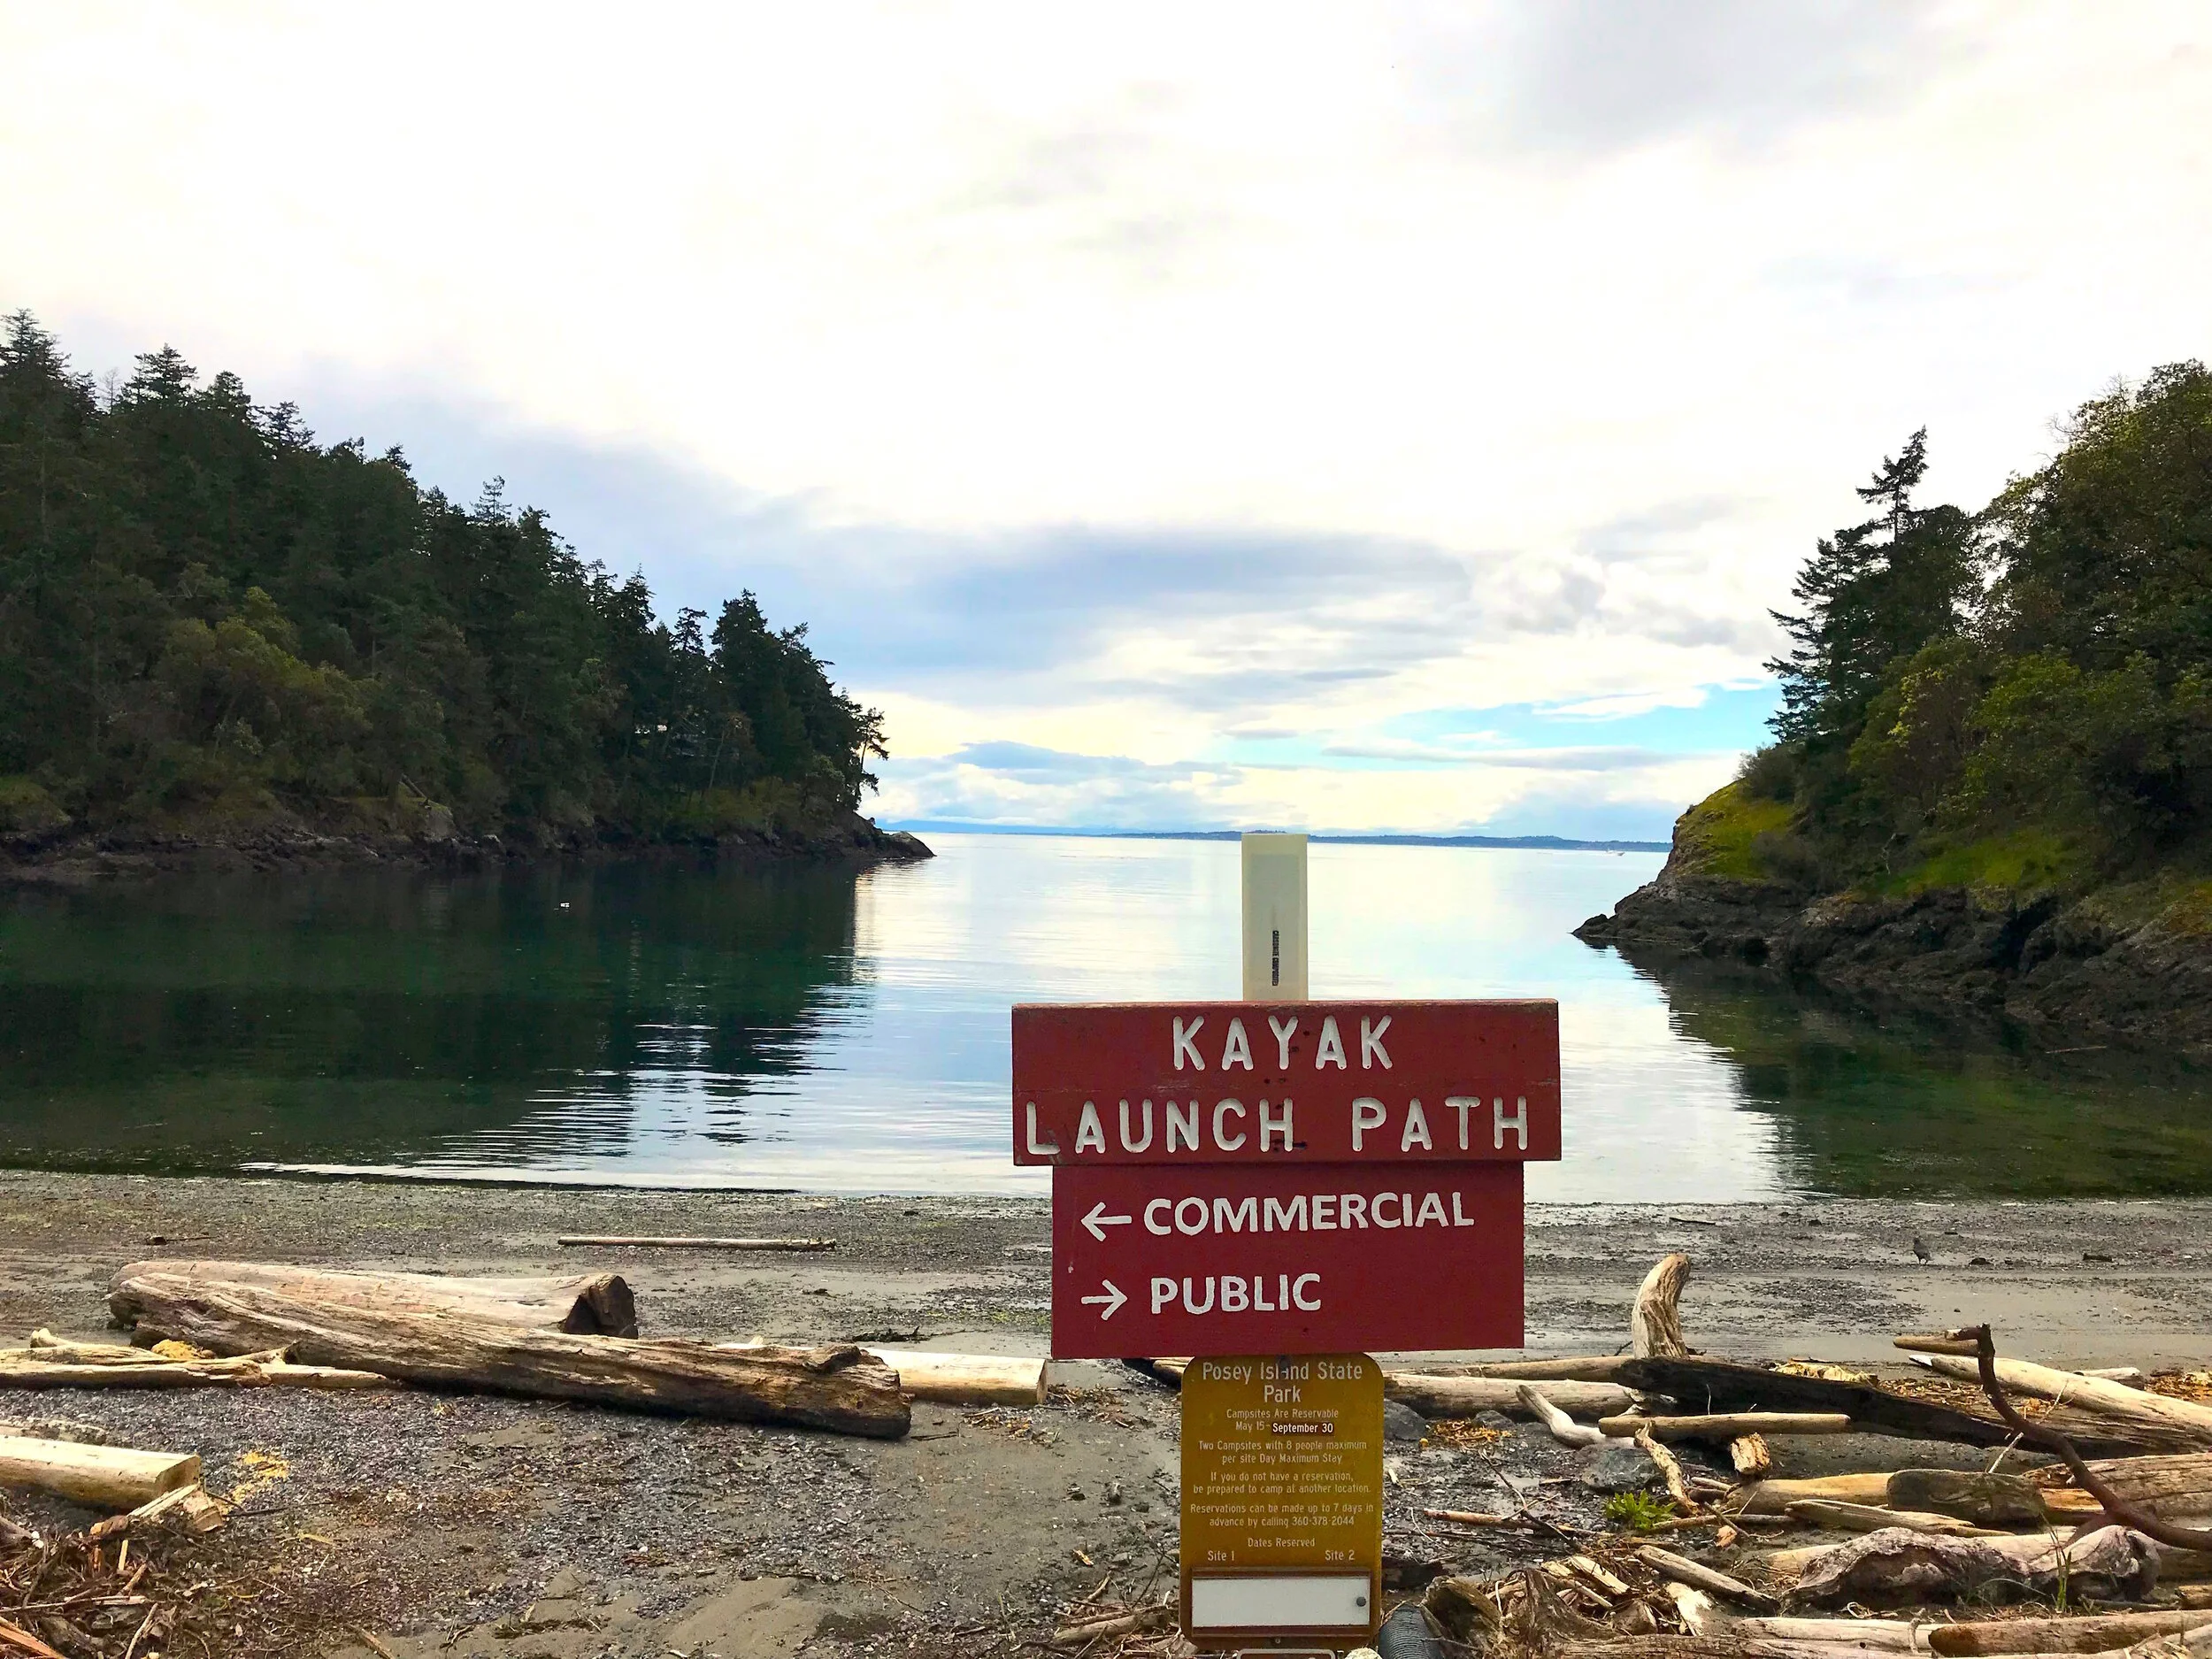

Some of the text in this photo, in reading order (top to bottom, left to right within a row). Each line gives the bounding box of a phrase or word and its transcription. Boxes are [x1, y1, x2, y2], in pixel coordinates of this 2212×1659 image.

[1172, 1015, 1393, 1071] KAYAK
[1026, 1096, 1528, 1156] LAUNCH PATH
[1144, 1191, 1475, 1235] COMMERCIAL
[1151, 1273, 1322, 1315] PUBLIC
[1203, 1363, 1252, 1384] Posey
[1317, 1363, 1363, 1380] State
[1264, 1386, 1301, 1402] Park
[1226, 1409, 1271, 1419] Campsites
[1236, 1422, 1252, 1432] May
[1272, 1424, 1318, 1434] September
[1322, 1424, 1333, 1432] 30
[1199, 1440, 1214, 1450] Two
[1217, 1440, 1262, 1451] Campsites
[1266, 1440, 1283, 1449] with
[1295, 1441, 1322, 1451] people
[1222, 1455, 1236, 1465] per
[1240, 1455, 1256, 1463] site
[1260, 1455, 1276, 1464] Day
[1323, 1454, 1342, 1463] Stay
[1211, 1472, 1217, 1481] If
[1221, 1473, 1236, 1483] you
[1240, 1472, 1248, 1481] do
[1253, 1472, 1266, 1481] not
[1271, 1472, 1290, 1481] have
[1194, 1485, 1203, 1494] be
[1207, 1485, 1245, 1495] prepared
[1248, 1485, 1256, 1494] to
[1191, 1504, 1246, 1513] Reservations
[1269, 1504, 1278, 1513] be
[1282, 1504, 1304, 1513] made
[1308, 1505, 1317, 1514] up
[1333, 1503, 1339, 1512] 7
[1342, 1503, 1363, 1514] days
[1363, 1503, 1373, 1512] in
[1210, 1517, 1244, 1526] advance
[1248, 1517, 1258, 1528] by
[1262, 1517, 1288, 1527] calling
[1248, 1538, 1315, 1547] Dates Reserved
[1208, 1551, 1235, 1562] Site 1
[1325, 1550, 1355, 1561] Site 2
